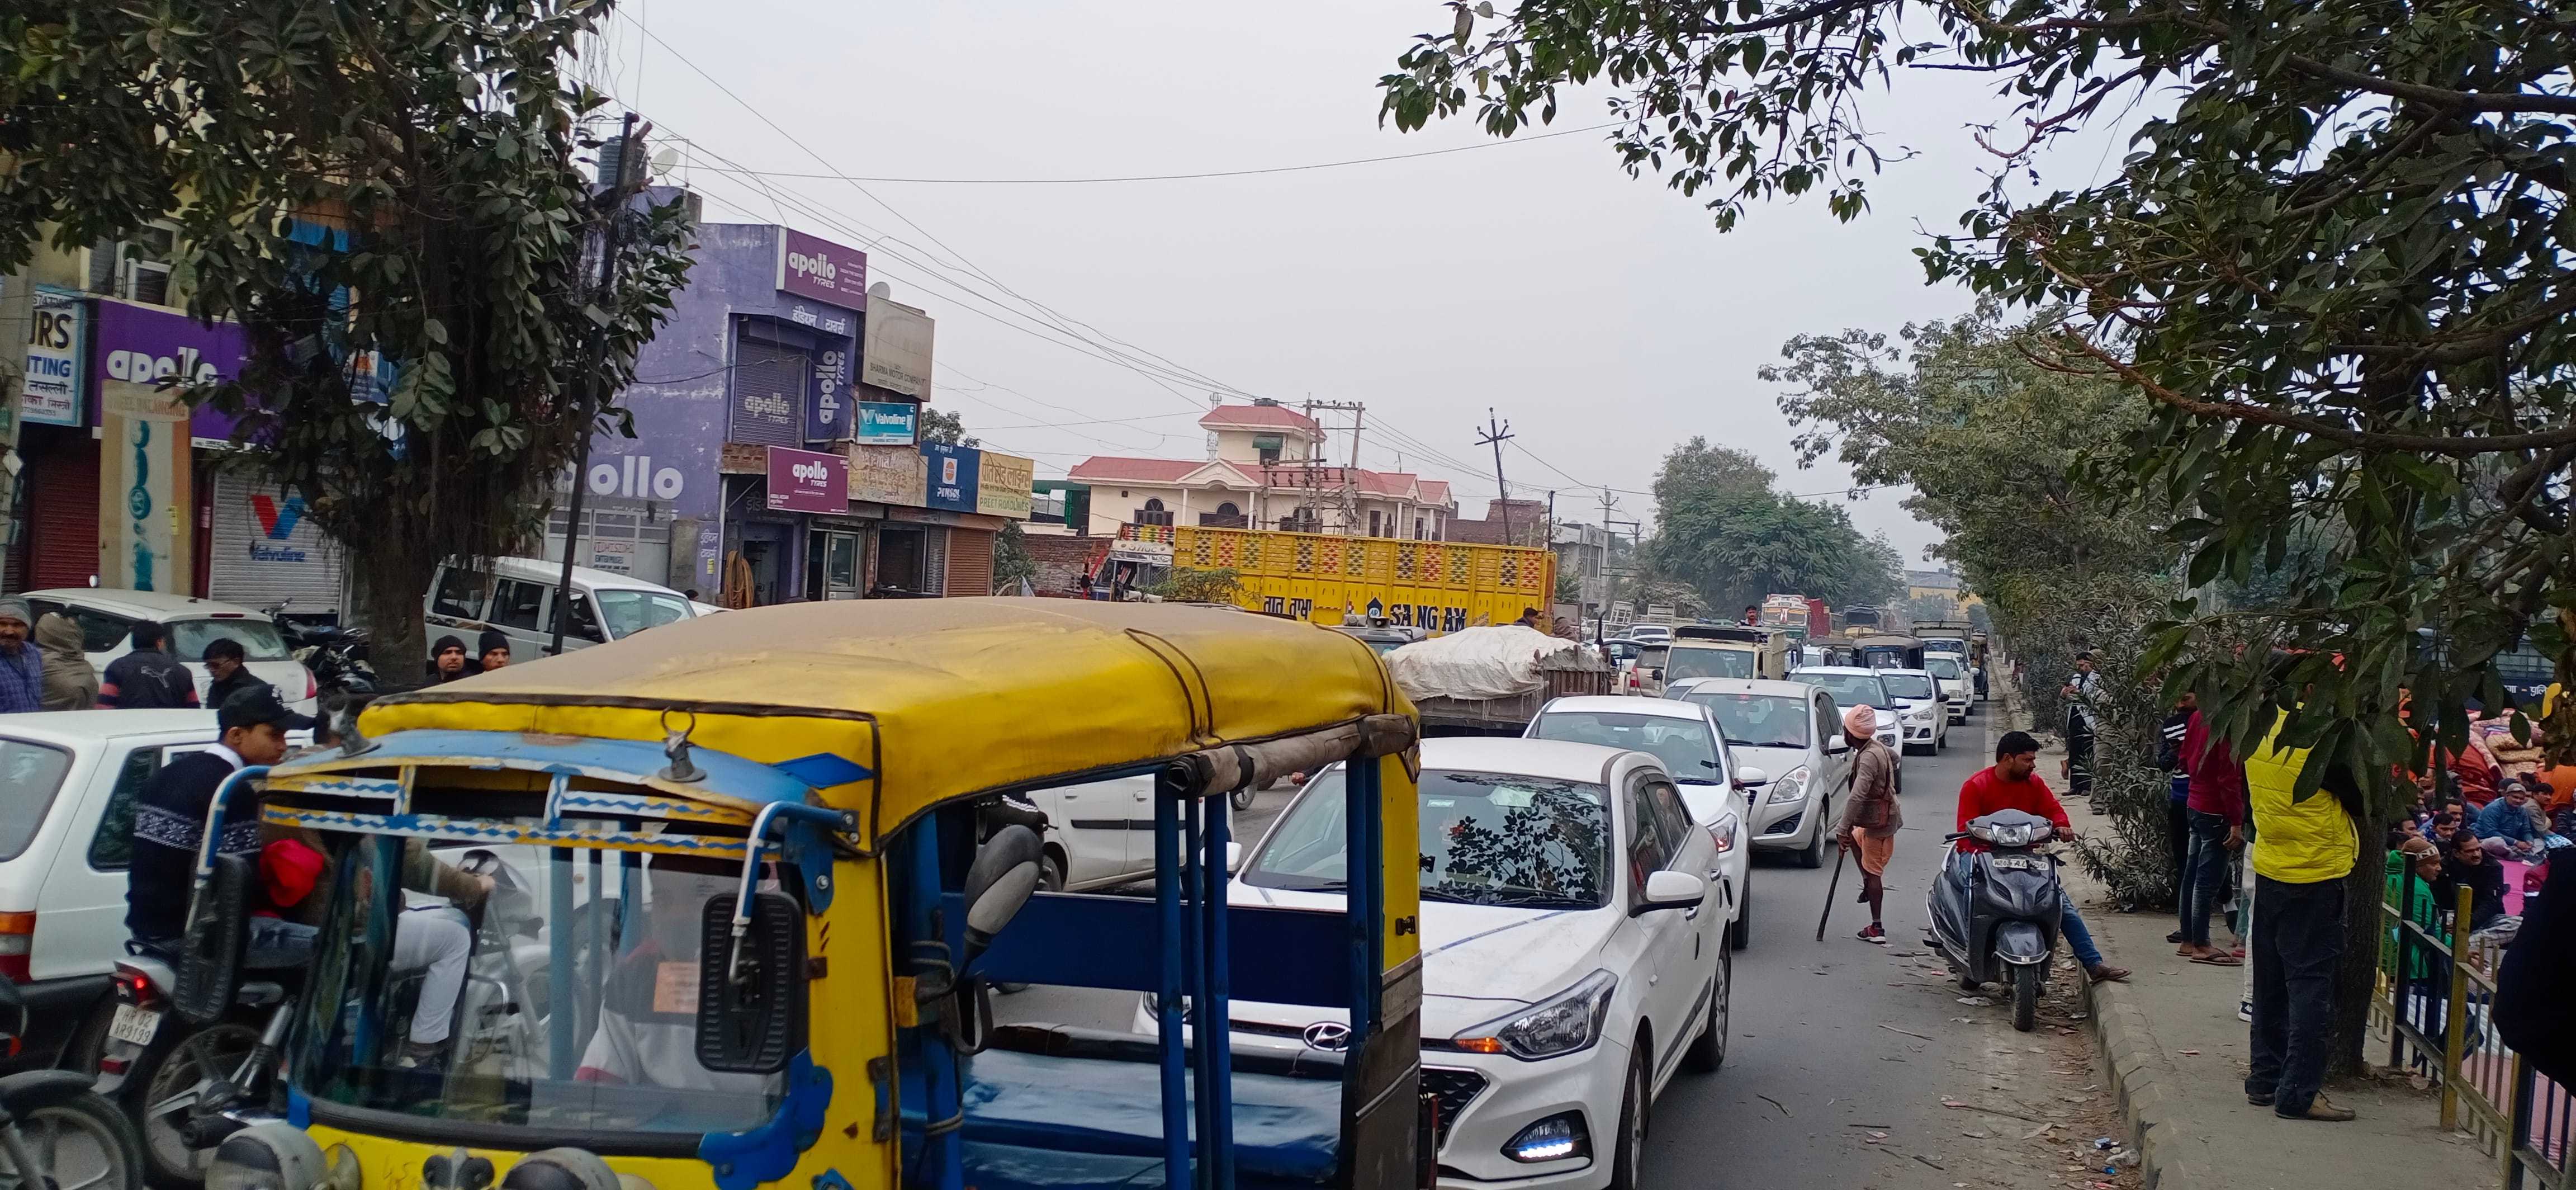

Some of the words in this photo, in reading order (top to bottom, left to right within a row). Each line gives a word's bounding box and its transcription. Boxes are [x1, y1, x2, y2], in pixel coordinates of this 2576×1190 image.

[788, 252, 836, 280] apollo
[813, 276, 835, 289] TYRES
[836, 351, 845, 386] TYRES
[816, 351, 840, 424] apollo
[745, 392, 790, 418] apollo
[875, 413, 906, 425] Valvoline
[793, 461, 827, 483] apollo
[979, 497, 997, 508] PREET
[2529, 684, 2548, 697] पुलि
